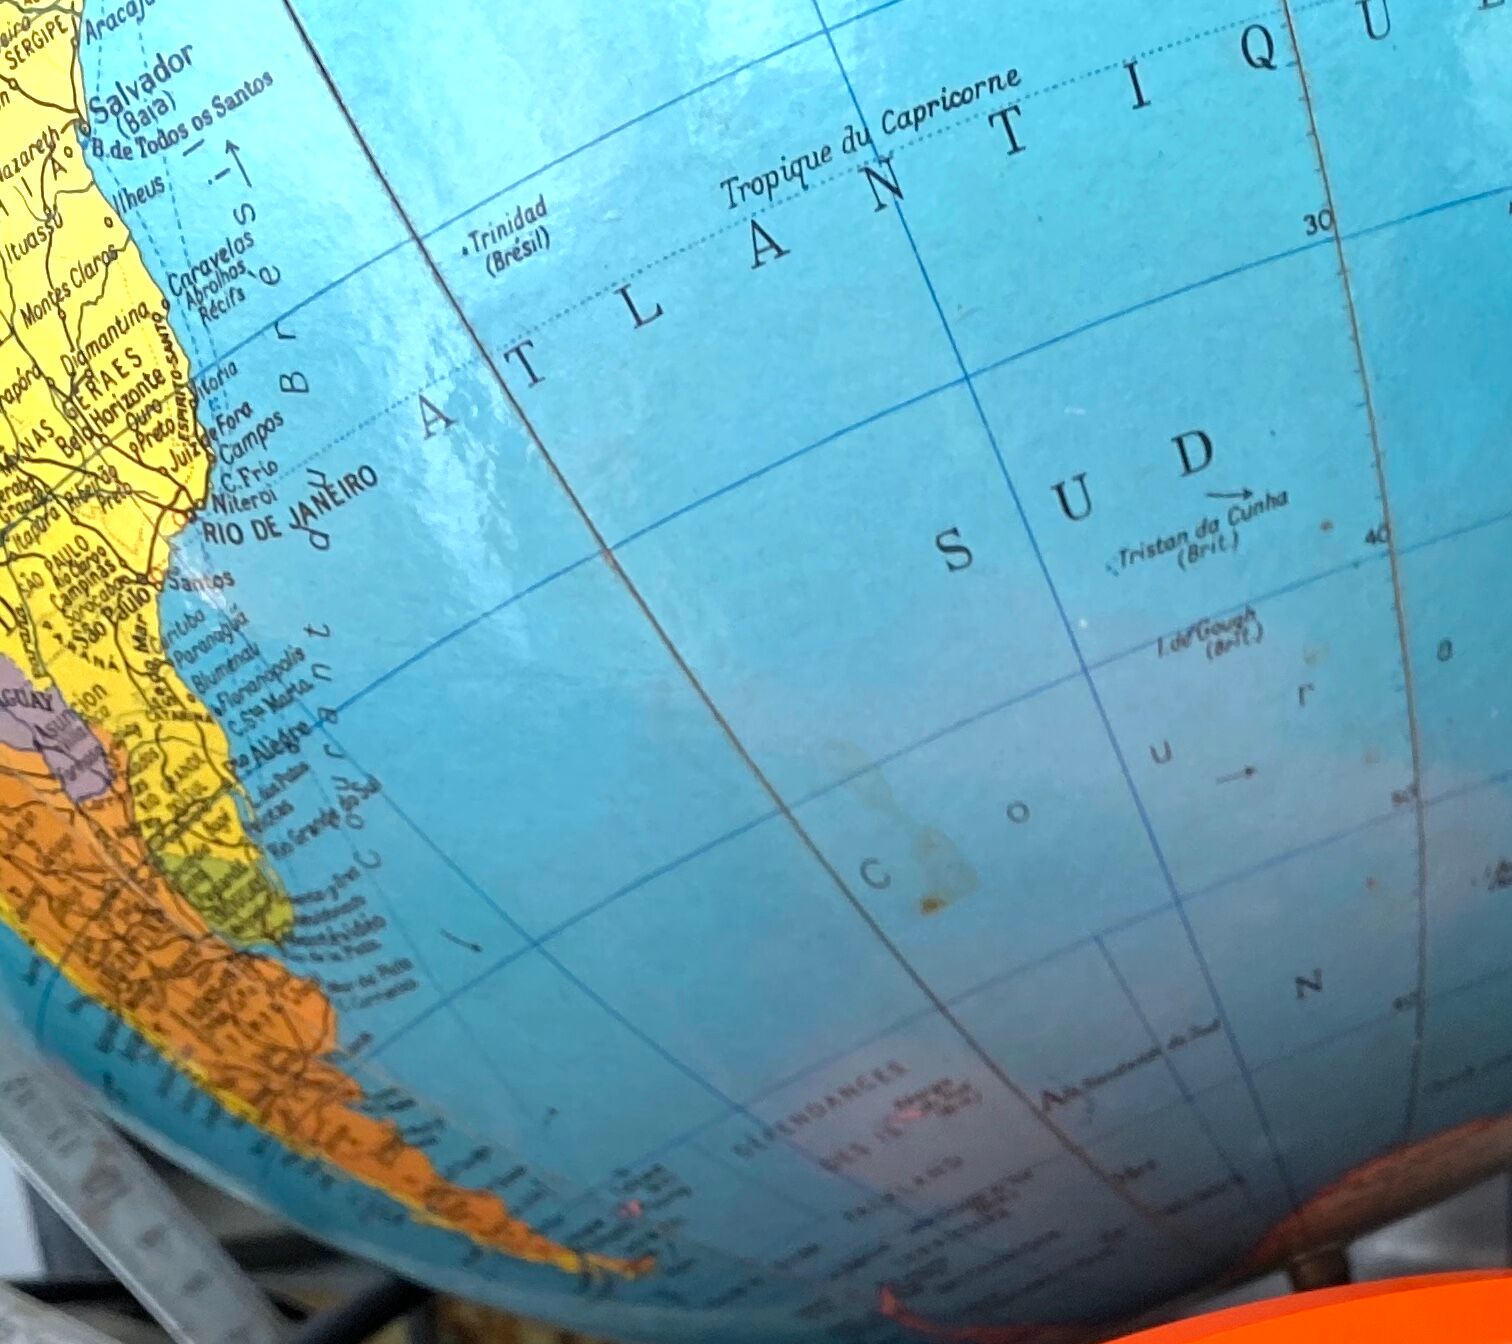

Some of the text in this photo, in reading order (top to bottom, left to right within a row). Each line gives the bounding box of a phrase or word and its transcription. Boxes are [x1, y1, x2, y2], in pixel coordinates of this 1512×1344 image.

[5, 14, 69, 70] SERGIPE
[89, 44, 193, 124] Salvador
[134, 123, 189, 158] Todos
[191, 108, 214, 131] os
[211, 71, 273, 119] Santos
[720, 67, 1022, 210] Tropique du Capricorne
[468, 194, 548, 256] Trinidad
[485, 226, 551, 278] (Brésil)
[1303, 208, 1335, 236] 30
[186, 259, 247, 311] Abrolhos
[60, 301, 151, 377] Diamantina
[89, 367, 166, 432] Horizonte
[219, 411, 285, 465] Campos
[202, 464, 379, 546] RIO DE JANEIRO
[1119, 530, 1189, 569] Tristan
[1227, 490, 1290, 526] Cunha
